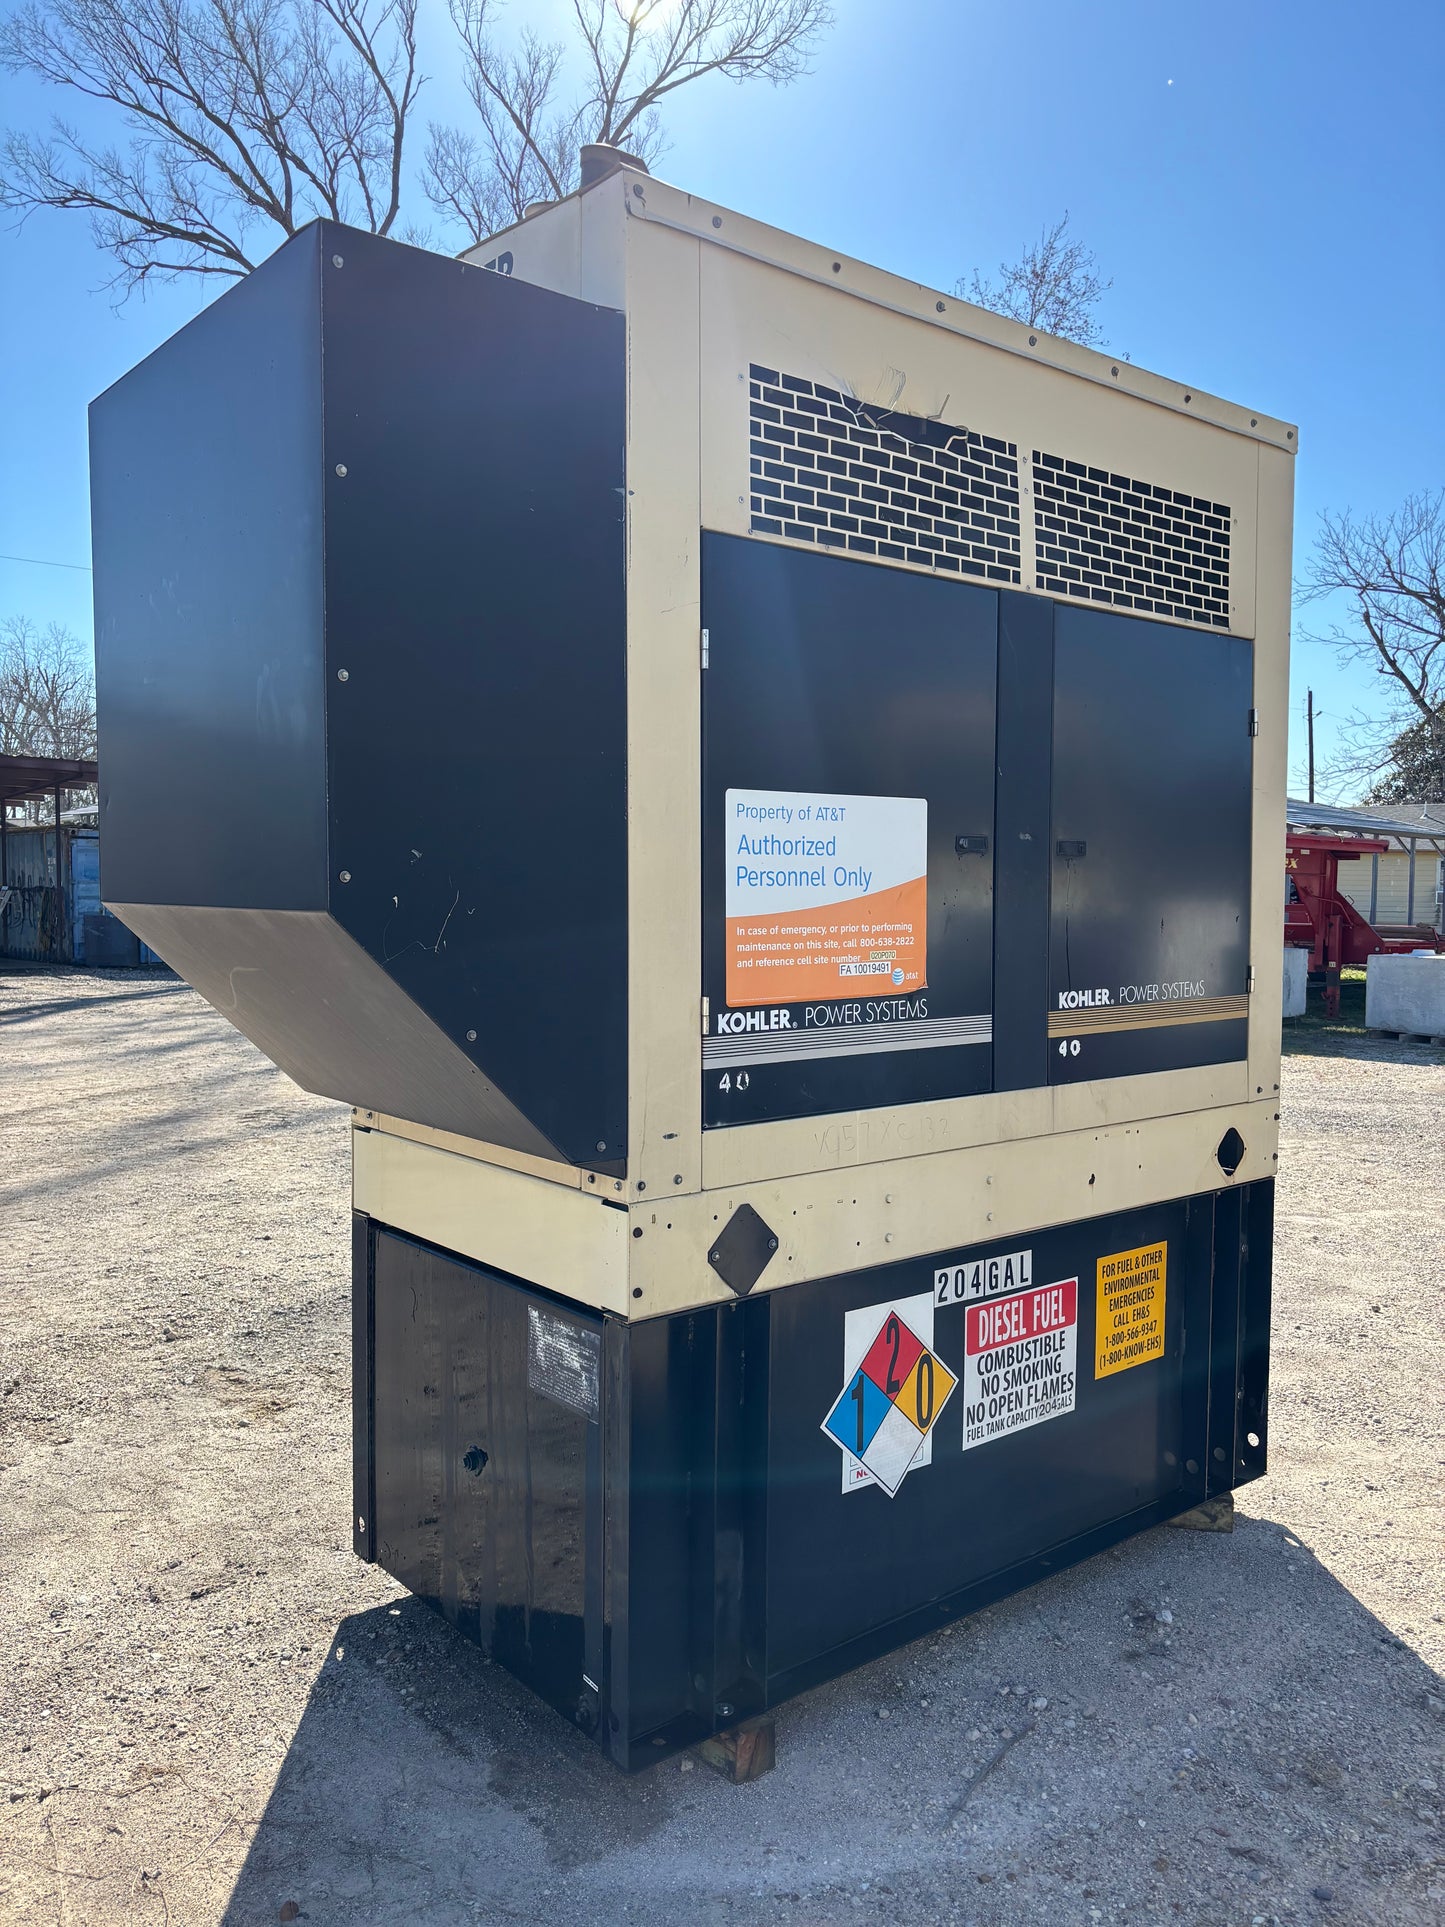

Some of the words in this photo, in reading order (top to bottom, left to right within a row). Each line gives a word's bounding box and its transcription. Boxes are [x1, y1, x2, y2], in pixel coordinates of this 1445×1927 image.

[736, 803, 794, 824] Property
[798, 806, 812, 821] of
[816, 806, 846, 821] AT&T
[737, 834, 836, 856] Authorized
[737, 865, 826, 887] Personnel
[834, 865, 872, 892] Only
[736, 926, 745, 936] In
[747, 927, 768, 936] case
[770, 925, 779, 935] of
[781, 926, 827, 937] emergency,
[829, 925, 838, 933] or
[840, 923, 860, 934] prior
[861, 923, 870, 932] to
[871, 922, 913, 934] performing
[736, 942, 791, 952] maintenance
[793, 942, 804, 950] on
[806, 940, 822, 949] this
[823, 940, 841, 949] site,
[842, 939, 857, 948] call
[860, 937, 915, 947] 800-638-2822
[737, 958, 753, 968] and
[755, 957, 795, 967] reference
[797, 955, 812, 965] cell
[814, 955, 829, 964] site
[831, 954, 861, 964] number
[840, 965, 852, 975] FA
[854, 963, 890, 974] 10019491
[1119, 984, 1159, 1003] POWER
[1161, 980, 1205, 1000] SYSTEMS
[805, 1003, 862, 1027] POWER
[866, 998, 929, 1023] SYSTEMS
[1058, 1039, 1081, 1057] 40
[1101, 1262, 1116, 1279] FOR
[1117, 1258, 1134, 1275] FUEL
[1135, 1256, 1140, 1269] &
[1141, 1249, 1163, 1268] OTHER
[1104, 1267, 1160, 1296] ENVIRONMENTAL
[1109, 1286, 1155, 1313] EMERGENCIES
[979, 1299, 1027, 1348] DIESEL
[1033, 1288, 1066, 1332] FUEL
[1113, 1311, 1129, 1328] CALL
[1132, 1304, 1150, 1322] EH&S
[1105, 1320, 1157, 1348] 1-800-566-9347
[886, 1317, 900, 1395] 2
[977, 1330, 1066, 1376] COMBUSTIBLE
[1099, 1335, 1162, 1371] (1-800-KNOW-EHS)
[981, 1373, 1000, 1399] NO
[1003, 1354, 1062, 1392] SMOKING
[916, 1353, 934, 1429] 0
[966, 1402, 986, 1427] NO
[989, 1388, 1023, 1419] OPEN
[1027, 1372, 1074, 1406] FLAMES
[851, 1374, 865, 1452] 1
[967, 1425, 985, 1443] FUEL
[986, 1417, 1006, 1436] TANK
[1006, 1404, 1039, 1428] CAPACITY
